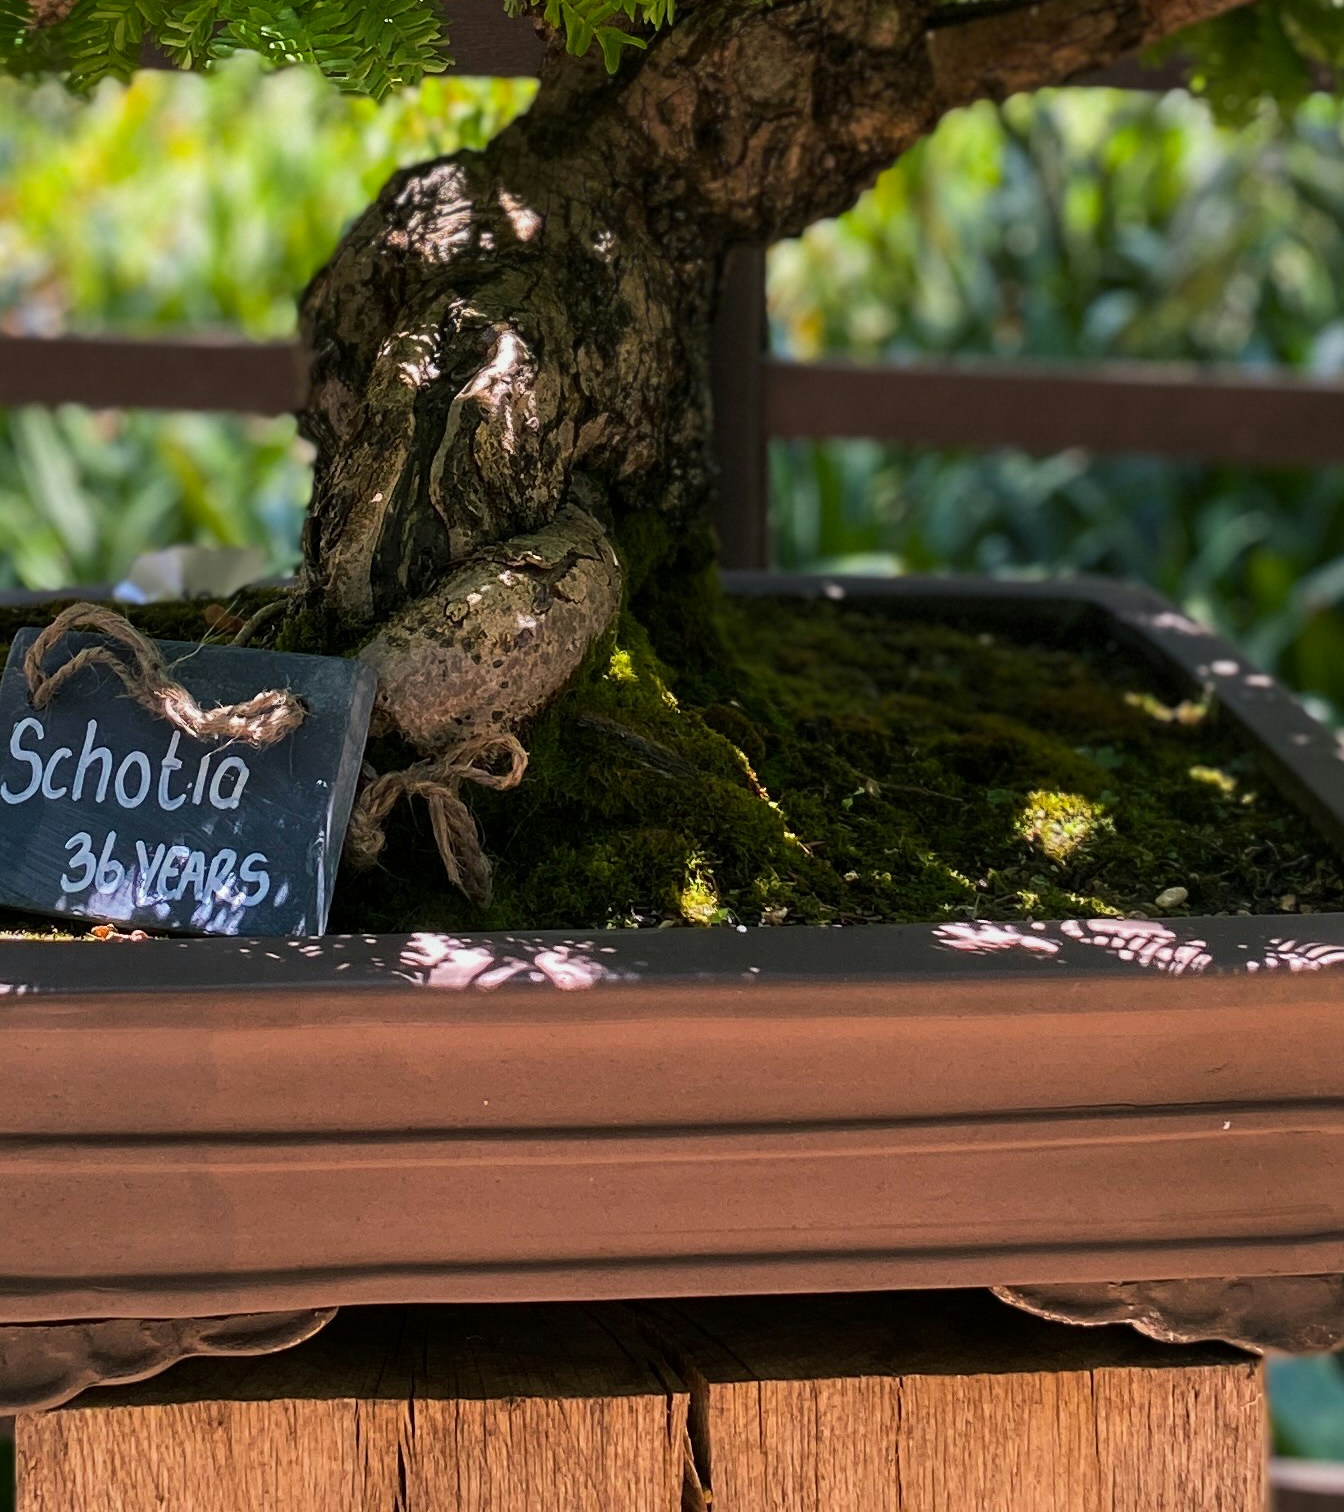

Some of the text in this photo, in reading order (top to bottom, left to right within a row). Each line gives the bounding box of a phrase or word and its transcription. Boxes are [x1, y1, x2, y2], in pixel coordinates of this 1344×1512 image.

[0, 717, 251, 811] Schotia
[60, 830, 271, 907] 36 YEARS
